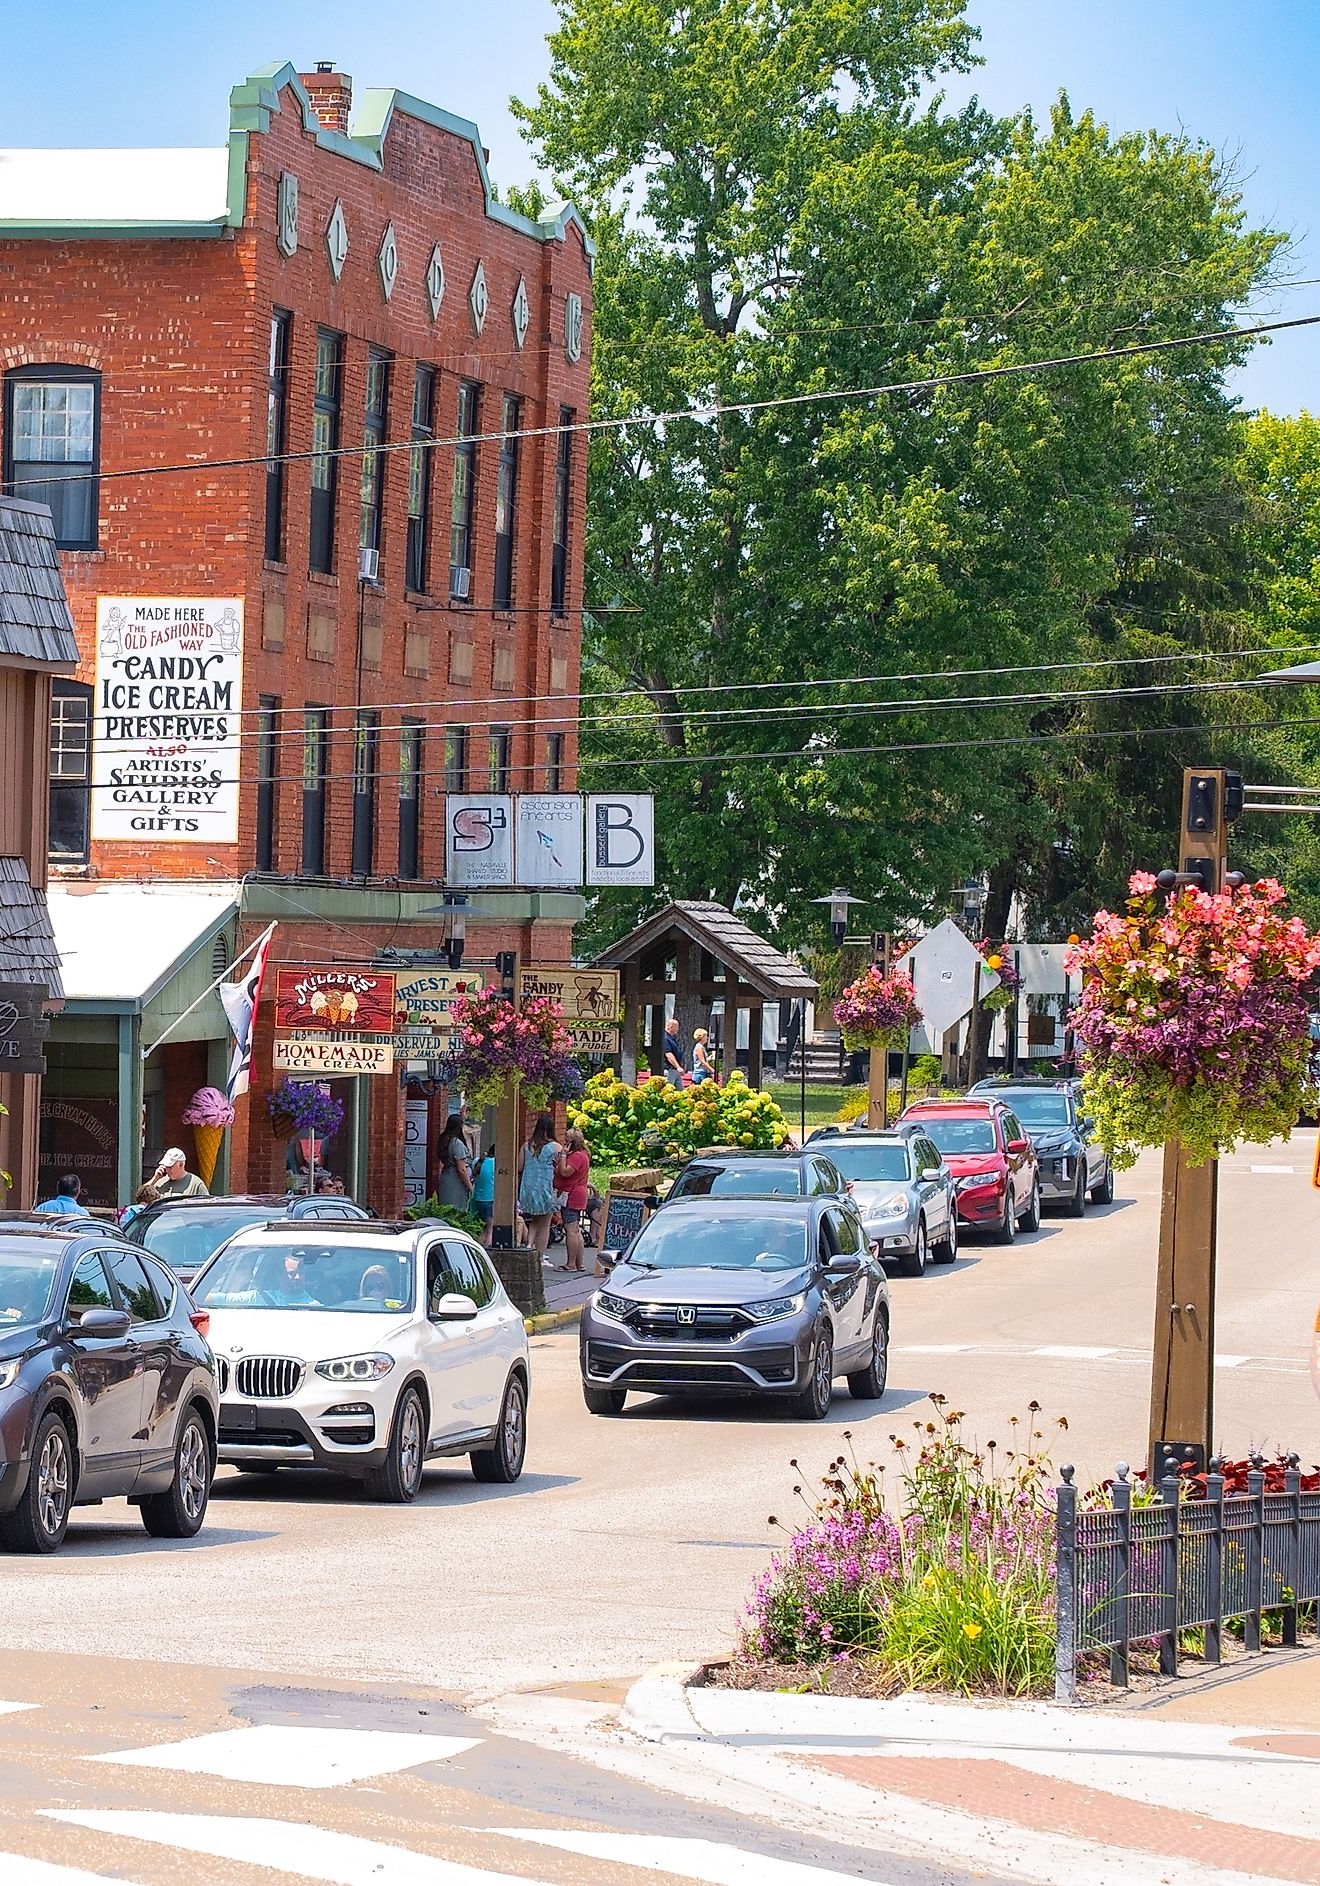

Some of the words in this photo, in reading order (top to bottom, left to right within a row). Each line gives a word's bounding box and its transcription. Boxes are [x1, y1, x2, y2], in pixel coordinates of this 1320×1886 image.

[135, 607, 170, 621] MADE
[174, 608, 204, 621] HERE
[128, 624, 146, 633] THE
[124, 633, 147, 650] OLD
[150, 622, 214, 647] FASHIONED
[179, 640, 204, 651] WAY
[112, 654, 224, 681] CANDY
[102, 679, 140, 709] ICE
[149, 681, 234, 710] CREAM
[105, 715, 228, 742] PRESERVES
[145, 743, 187, 757] ALSO
[126, 759, 207, 773] ARTISTS'
[110, 768, 223, 789] STUDIOS
[112, 789, 218, 805] GALLERY
[157, 805, 172, 816] &
[521, 811, 544, 821] fine
[545, 811, 573, 821] arts
[130, 816, 199, 832] GIFTS
[596, 803, 645, 868] B
[522, 974, 538, 982] THE
[395, 977, 450, 1001] ARVEST
[523, 982, 564, 995] CANDY
[564, 1029, 612, 1043] MADE
[276, 1043, 386, 1062] HOMEMADE
[581, 1042, 612, 1051] FUDGE
[414, 1050, 436, 1058] JAMS
[286, 1058, 312, 1068] ICE
[324, 1060, 377, 1070] CREAM
[39, 1102, 53, 1118] CE
[52, 1103, 87, 1127] CREAM
[84, 1114, 115, 1150] HOUSE
[74, 1154, 113, 1168] CREAM
